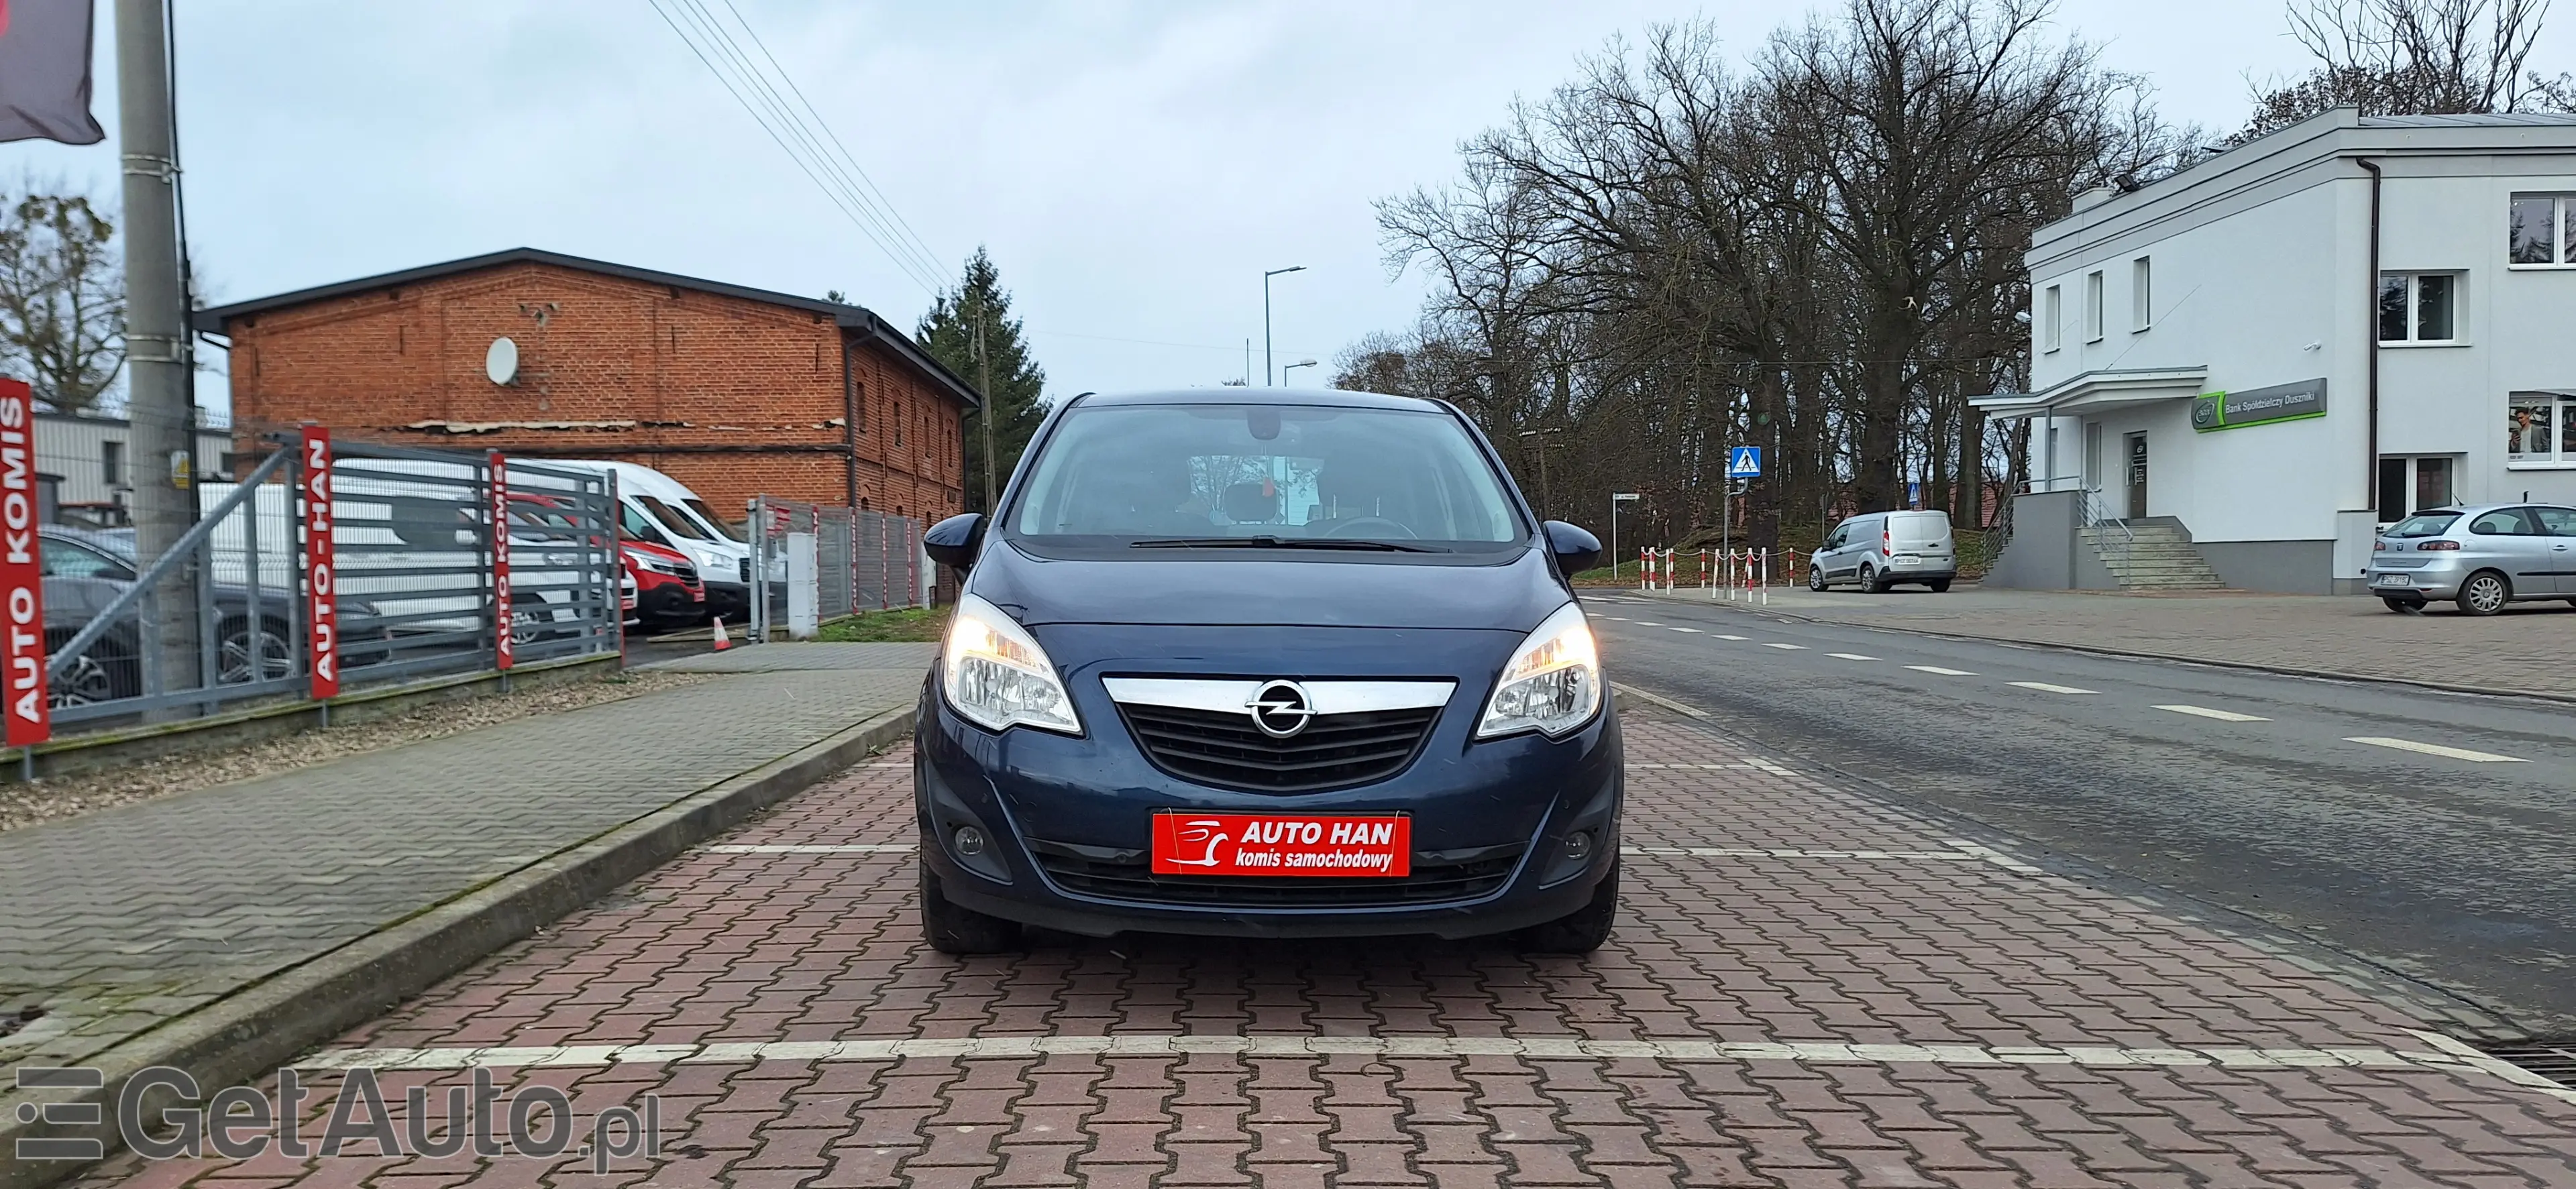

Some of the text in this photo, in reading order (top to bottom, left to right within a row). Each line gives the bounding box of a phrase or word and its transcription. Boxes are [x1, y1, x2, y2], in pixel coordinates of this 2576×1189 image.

[2225, 403, 2241, 414] Bank
[2243, 398, 2284, 412] Spółdzielczy
[2285, 391, 2314, 404] Duszniki
[0, 396, 40, 723] AUTO KOMIS
[494, 463, 510, 656] AUTO KOMIS
[1241, 822, 1393, 845] AUTO HAN
[1235, 848, 1393, 872] komis samochodowy
